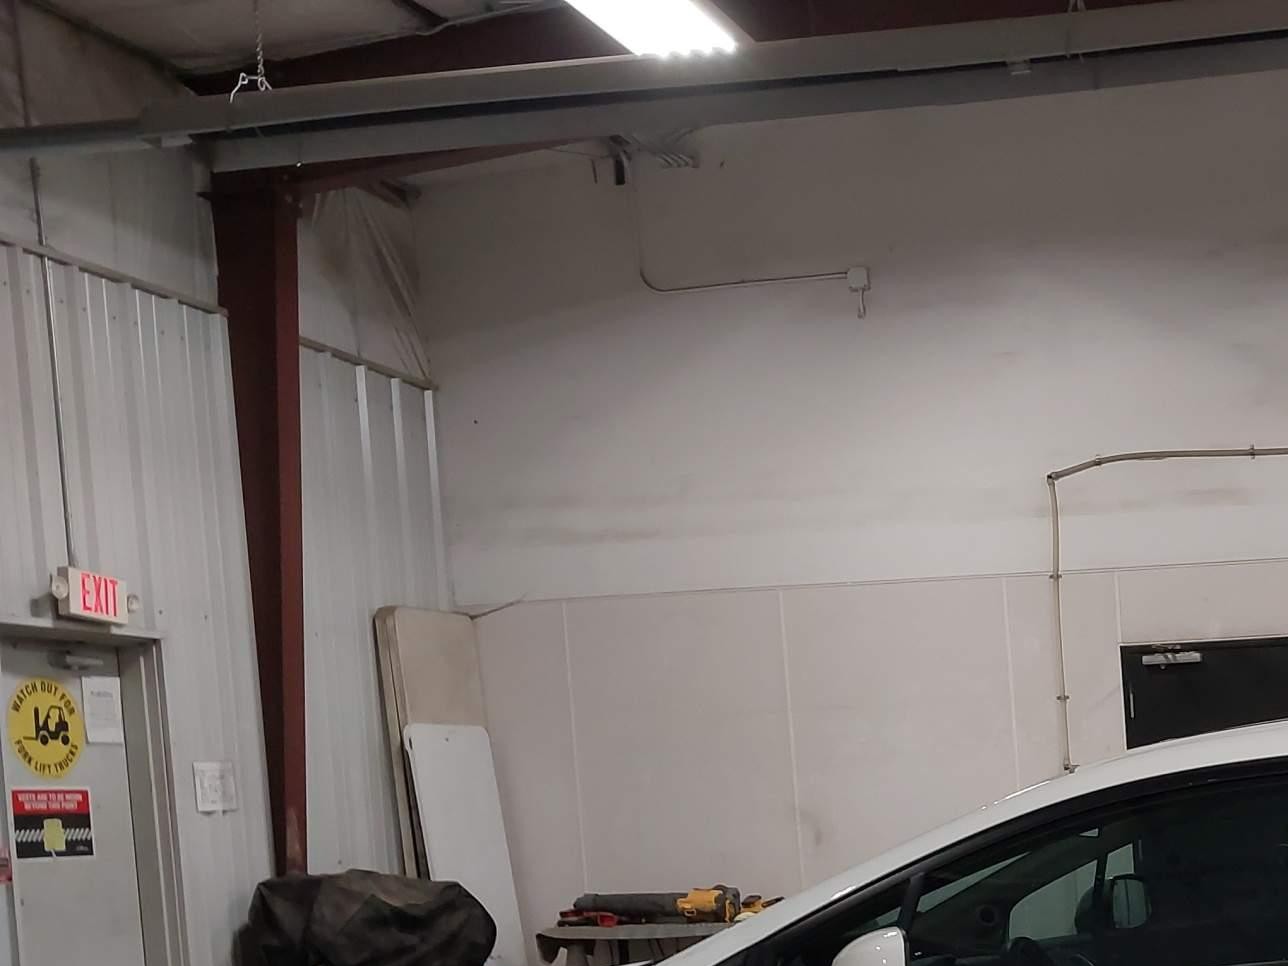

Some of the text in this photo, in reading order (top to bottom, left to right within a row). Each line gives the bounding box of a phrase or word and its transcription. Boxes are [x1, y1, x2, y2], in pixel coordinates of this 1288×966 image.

[81, 572, 118, 617] EXIT
[11, 681, 38, 713] WATCH
[40, 681, 58, 696] OUT
[59, 692, 76, 717] FOR
[14, 739, 78, 775] FORK LIFT TRUCKS
